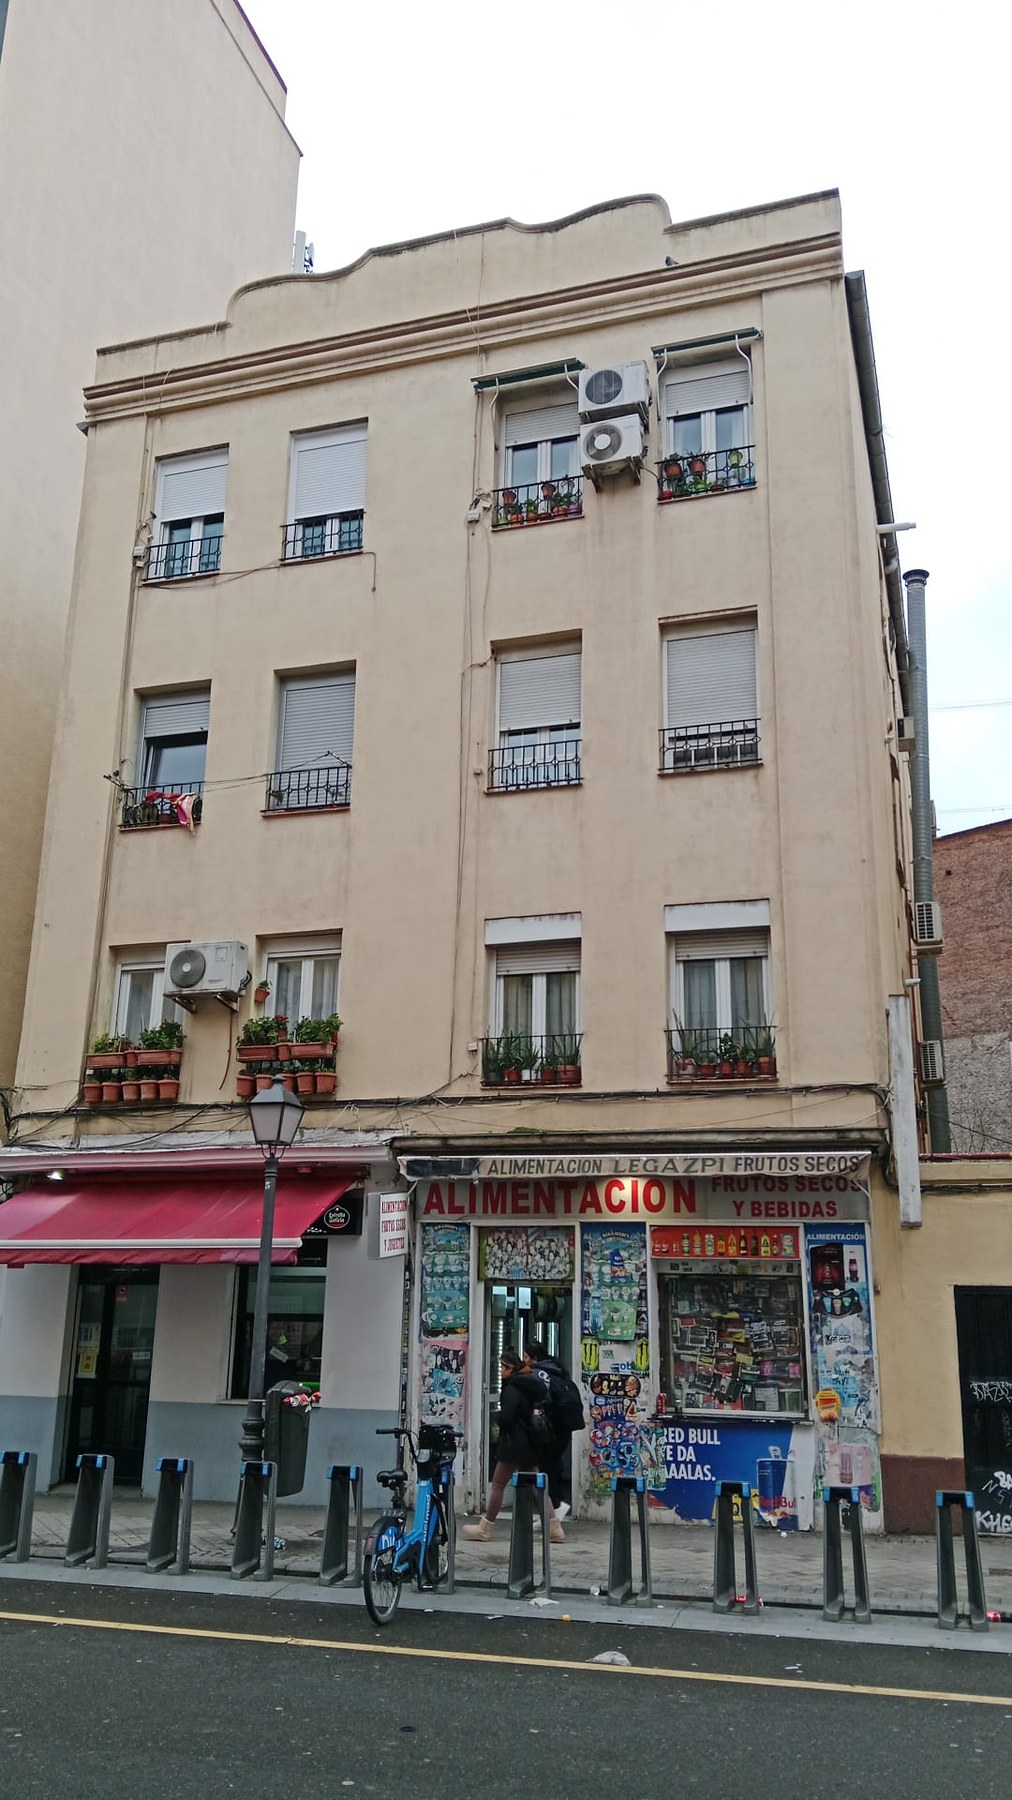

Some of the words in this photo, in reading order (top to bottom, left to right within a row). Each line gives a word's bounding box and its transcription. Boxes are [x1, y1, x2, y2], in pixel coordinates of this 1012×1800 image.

[487, 1158, 601, 1176] ALIMENTACION
[613, 1157, 724, 1174] LEGAZPI
[734, 1156, 800, 1172] FRUTOS
[804, 1155, 860, 1173] SECOS
[711, 1175, 790, 1193] FRUTOS
[795, 1175, 863, 1193] SECOS
[423, 1178, 697, 1216] ALIMENTACION
[732, 1200, 745, 1217] Y
[751, 1200, 838, 1218] BEBIDAS
[806, 1232, 865, 1241] ALIMENTACIÓN
[688, 1428, 721, 1445] BULL
[677, 1445, 697, 1462] DA
